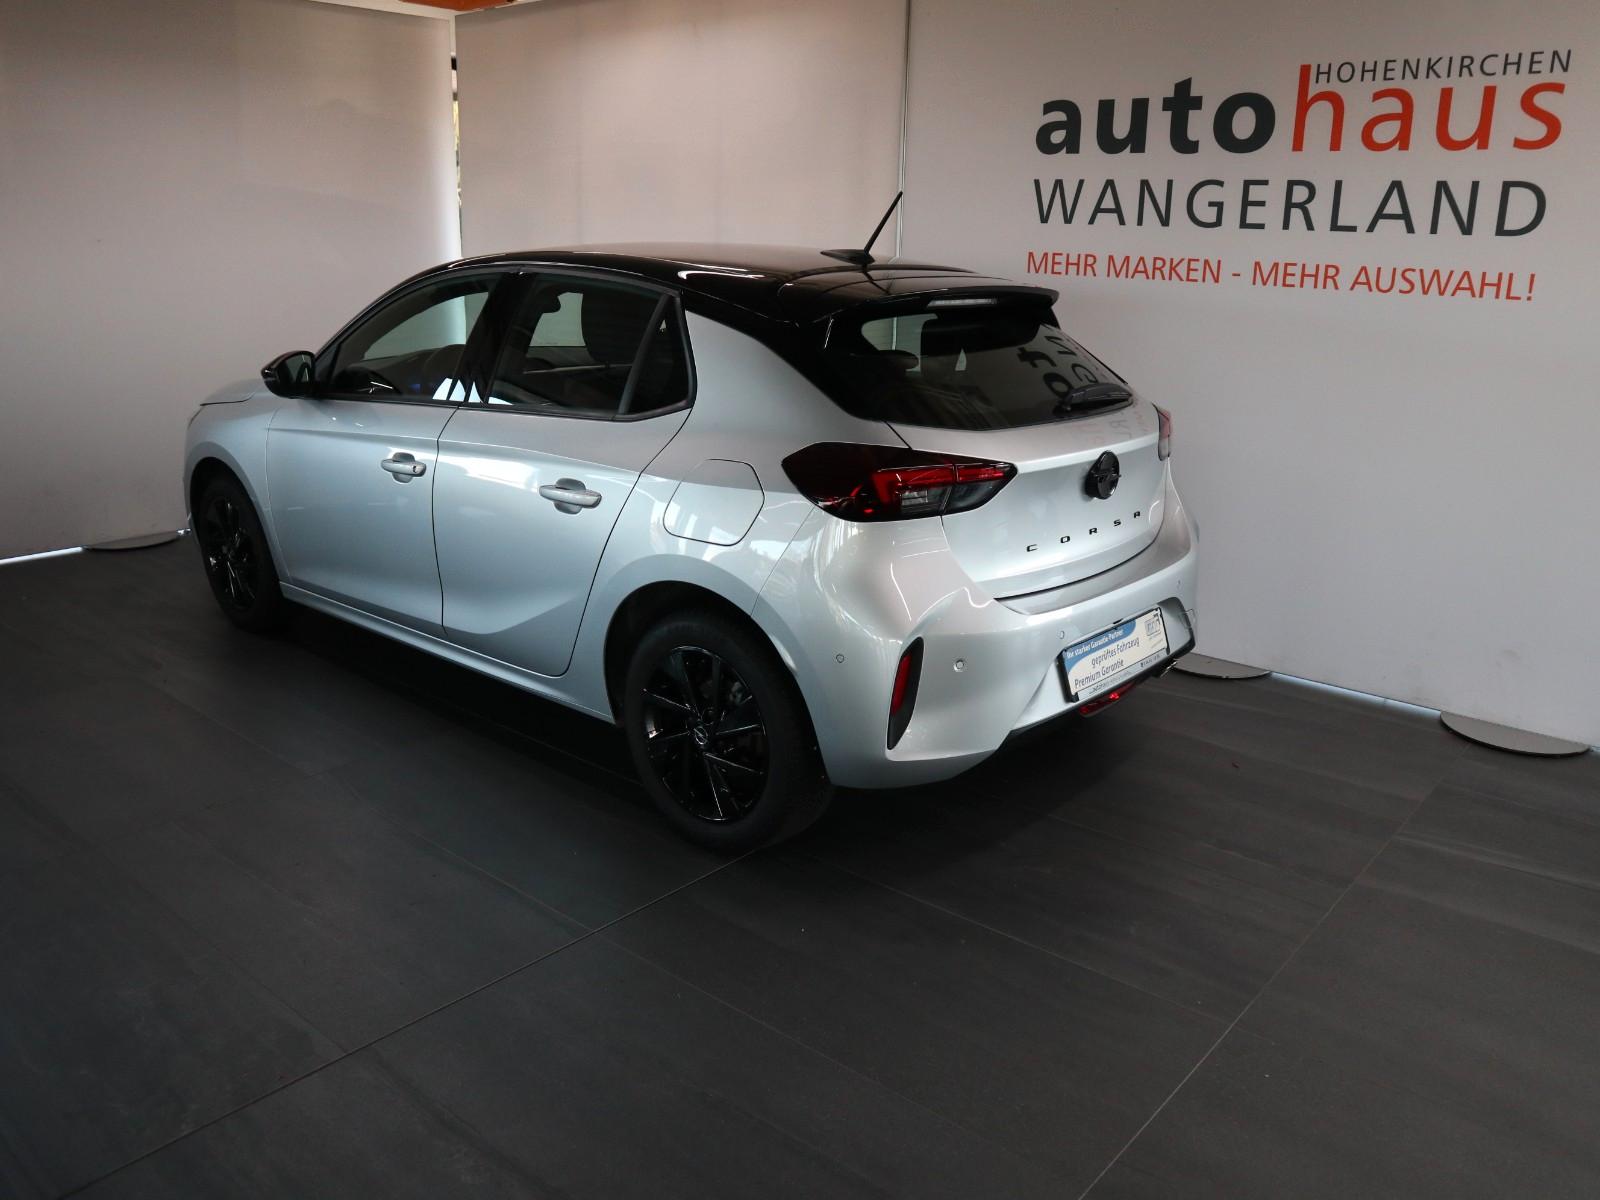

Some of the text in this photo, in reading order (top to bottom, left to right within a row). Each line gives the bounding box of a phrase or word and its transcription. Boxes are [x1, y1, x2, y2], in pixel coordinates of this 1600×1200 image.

[1315, 49, 1572, 84] HOHENKIRCHEN
[1033, 178, 1547, 237] WANGERLAND
[1027, 251, 1097, 277] MEHR
[1106, 254, 1222, 284] MARKEN
[1252, 260, 1340, 291] MEHR
[1349, 265, 1536, 301] AUSWAHL!
[1026, 511, 1141, 552] CORSA
[1116, 637, 1140, 655] Fahrzeug
[1074, 671, 1101, 689] Premium
[1101, 660, 1124, 676] Garantie
